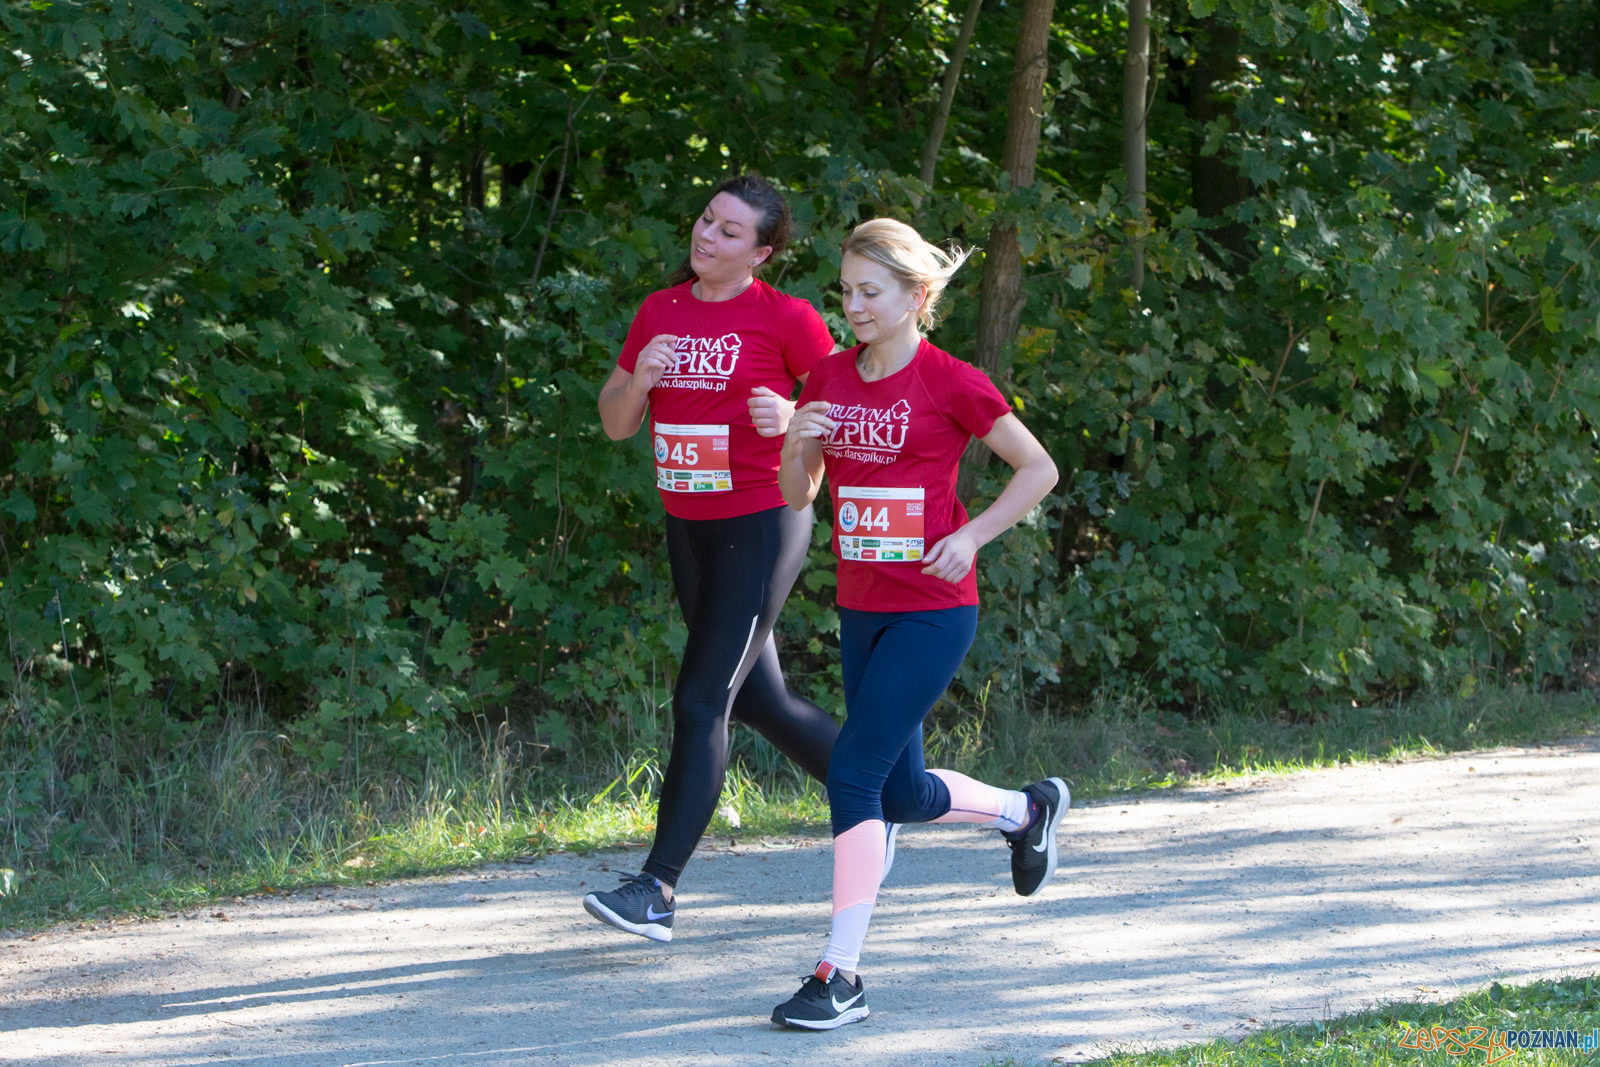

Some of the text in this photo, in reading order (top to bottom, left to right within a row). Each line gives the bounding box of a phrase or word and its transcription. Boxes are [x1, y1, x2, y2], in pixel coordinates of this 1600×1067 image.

[675, 334, 722, 352] ŻYNA
[664, 350, 739, 375] PIKU
[655, 378, 726, 392] w.darszpiku.pl
[670, 442, 699, 466] 45
[860, 506, 890, 532] 44
